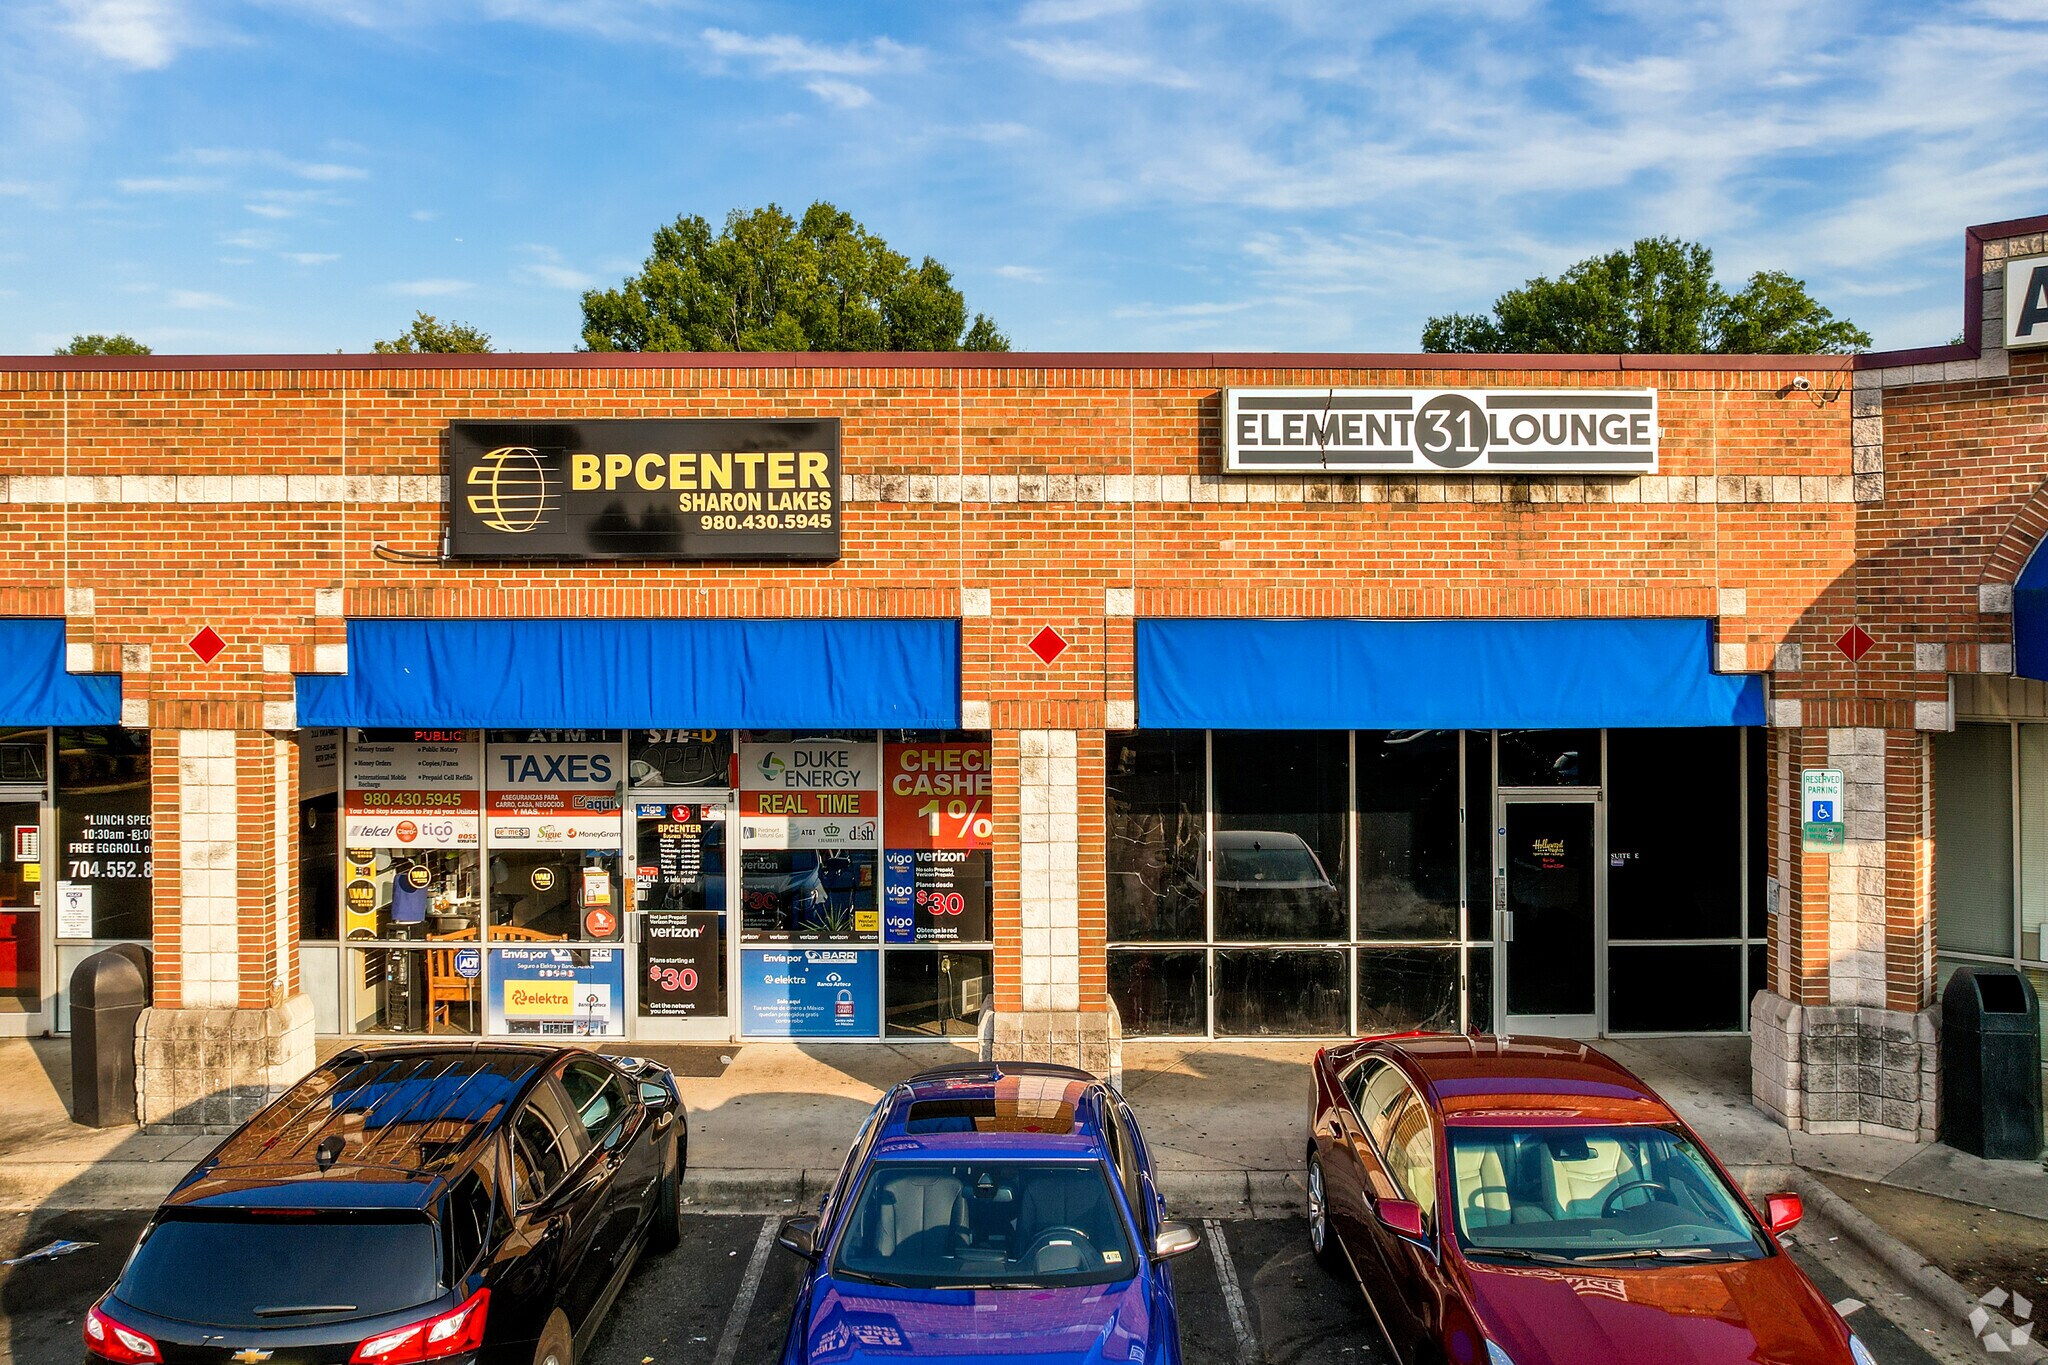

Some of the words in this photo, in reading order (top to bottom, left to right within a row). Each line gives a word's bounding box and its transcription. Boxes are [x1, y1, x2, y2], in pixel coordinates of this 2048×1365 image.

[1236, 413, 1414, 446] ELEMENT
[1424, 409, 1480, 452] 31
[1488, 413, 1651, 446] LOUNGE
[571, 451, 831, 491] BPCENTER
[679, 491, 762, 513] SHARON
[768, 491, 832, 512] LAKES
[700, 514, 832, 530] 980.430.5945
[414, 731, 462, 741] PUBLIC
[794, 750, 849, 768] DUKE
[500, 754, 612, 782] TAXES
[785, 770, 861, 787] ENERGY
[1805, 775, 1840, 784] RESERVED
[1807, 786, 1838, 795] PARKING
[363, 792, 462, 806] 980.430.5945
[759, 794, 808, 814] REAL
[816, 794, 860, 814] TIME
[423, 808, 433, 816] Pay
[641, 804, 662, 814] vigo
[918, 799, 993, 839] 1%
[82, 829, 125, 840] 10:30am
[360, 825, 395, 837] telcel
[657, 824, 702, 833] BPCENTER
[849, 823, 874, 841] dish
[69, 842, 94, 854] FREE
[96, 842, 142, 854] EGGROLL
[886, 853, 912, 865] vigo
[916, 850, 966, 862] verizon
[886, 884, 912, 896] vigo
[916, 889, 965, 916] $30
[886, 916, 912, 928] vigo
[650, 925, 699, 938] verizon
[501, 949, 529, 959] Envía
[530, 950, 548, 961] por
[763, 953, 786, 963] Envía
[787, 954, 802, 964] por
[822, 951, 857, 960] BARRI
[461, 957, 478, 968] ADT
[650, 965, 698, 991] $30
[774, 975, 806, 984] elektra
[528, 992, 568, 1005] elektra
